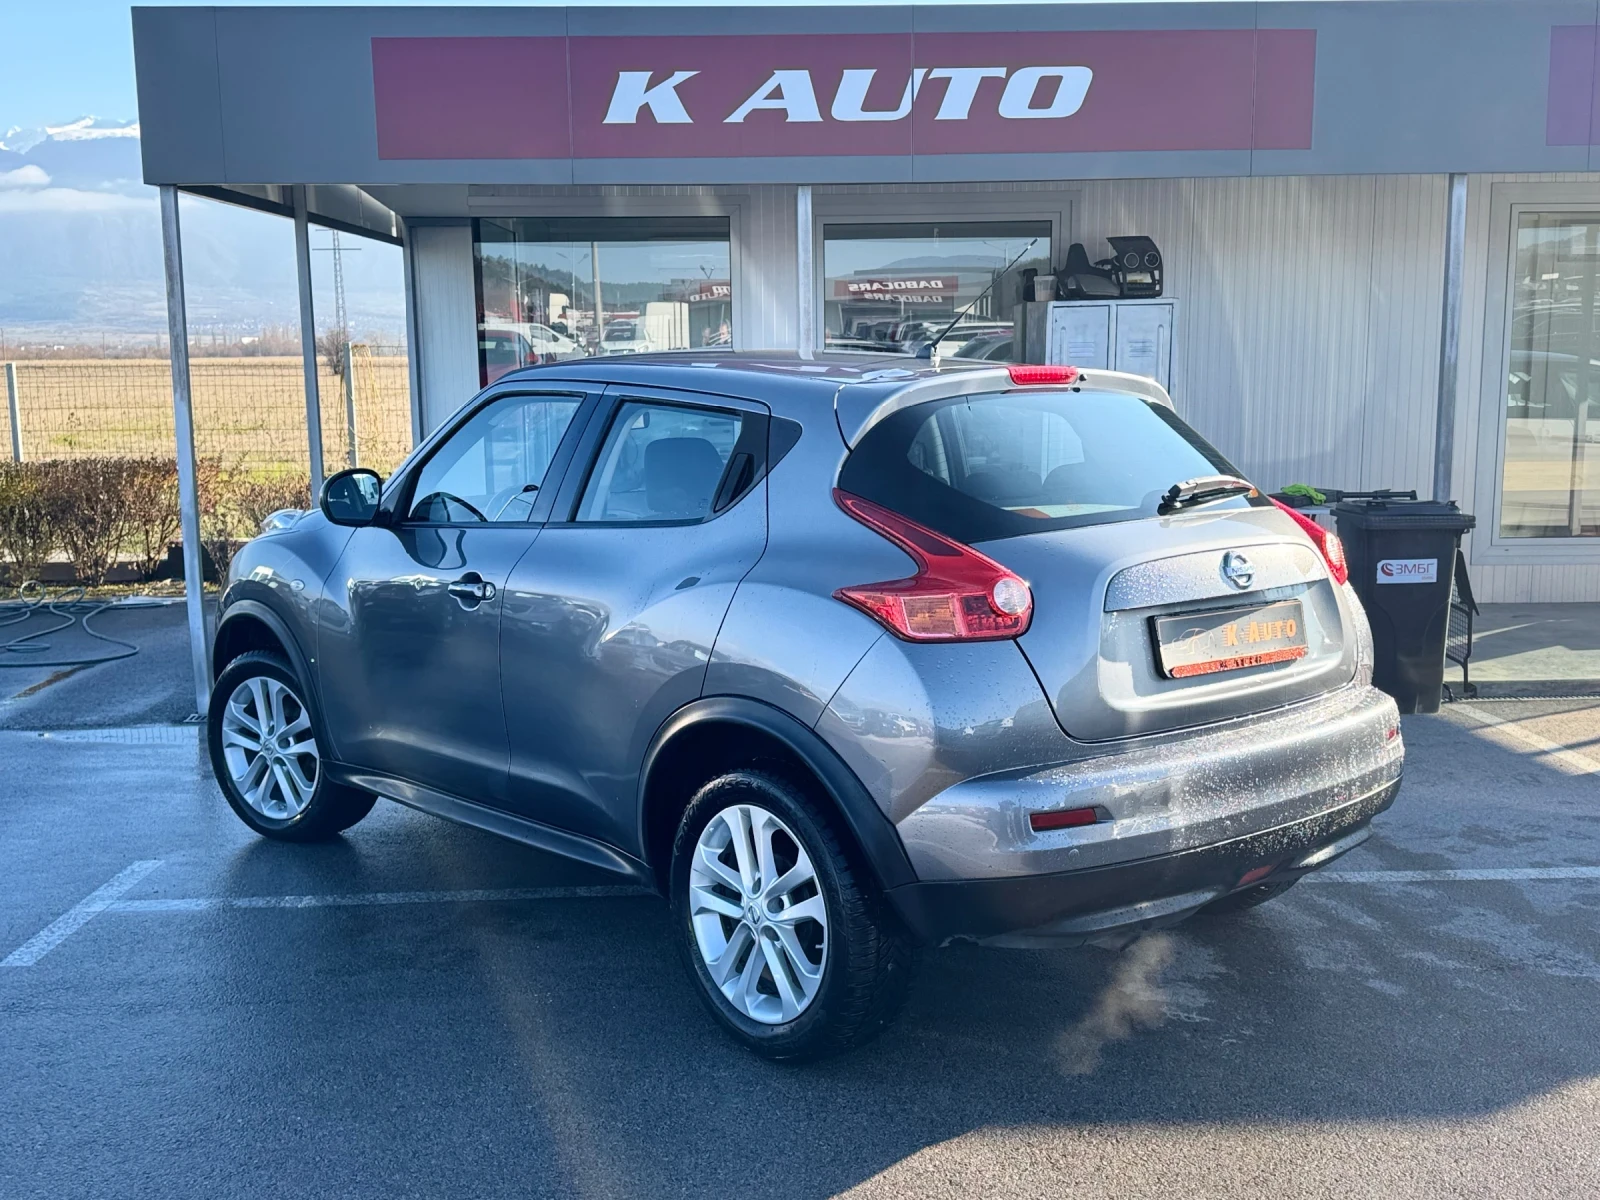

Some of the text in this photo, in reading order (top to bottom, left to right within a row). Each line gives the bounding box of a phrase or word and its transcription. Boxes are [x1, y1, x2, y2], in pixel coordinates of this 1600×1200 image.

[602, 66, 1093, 124] K AUTO
[1395, 563, 1434, 575] ЗМБГ
[1224, 624, 1239, 646] K
